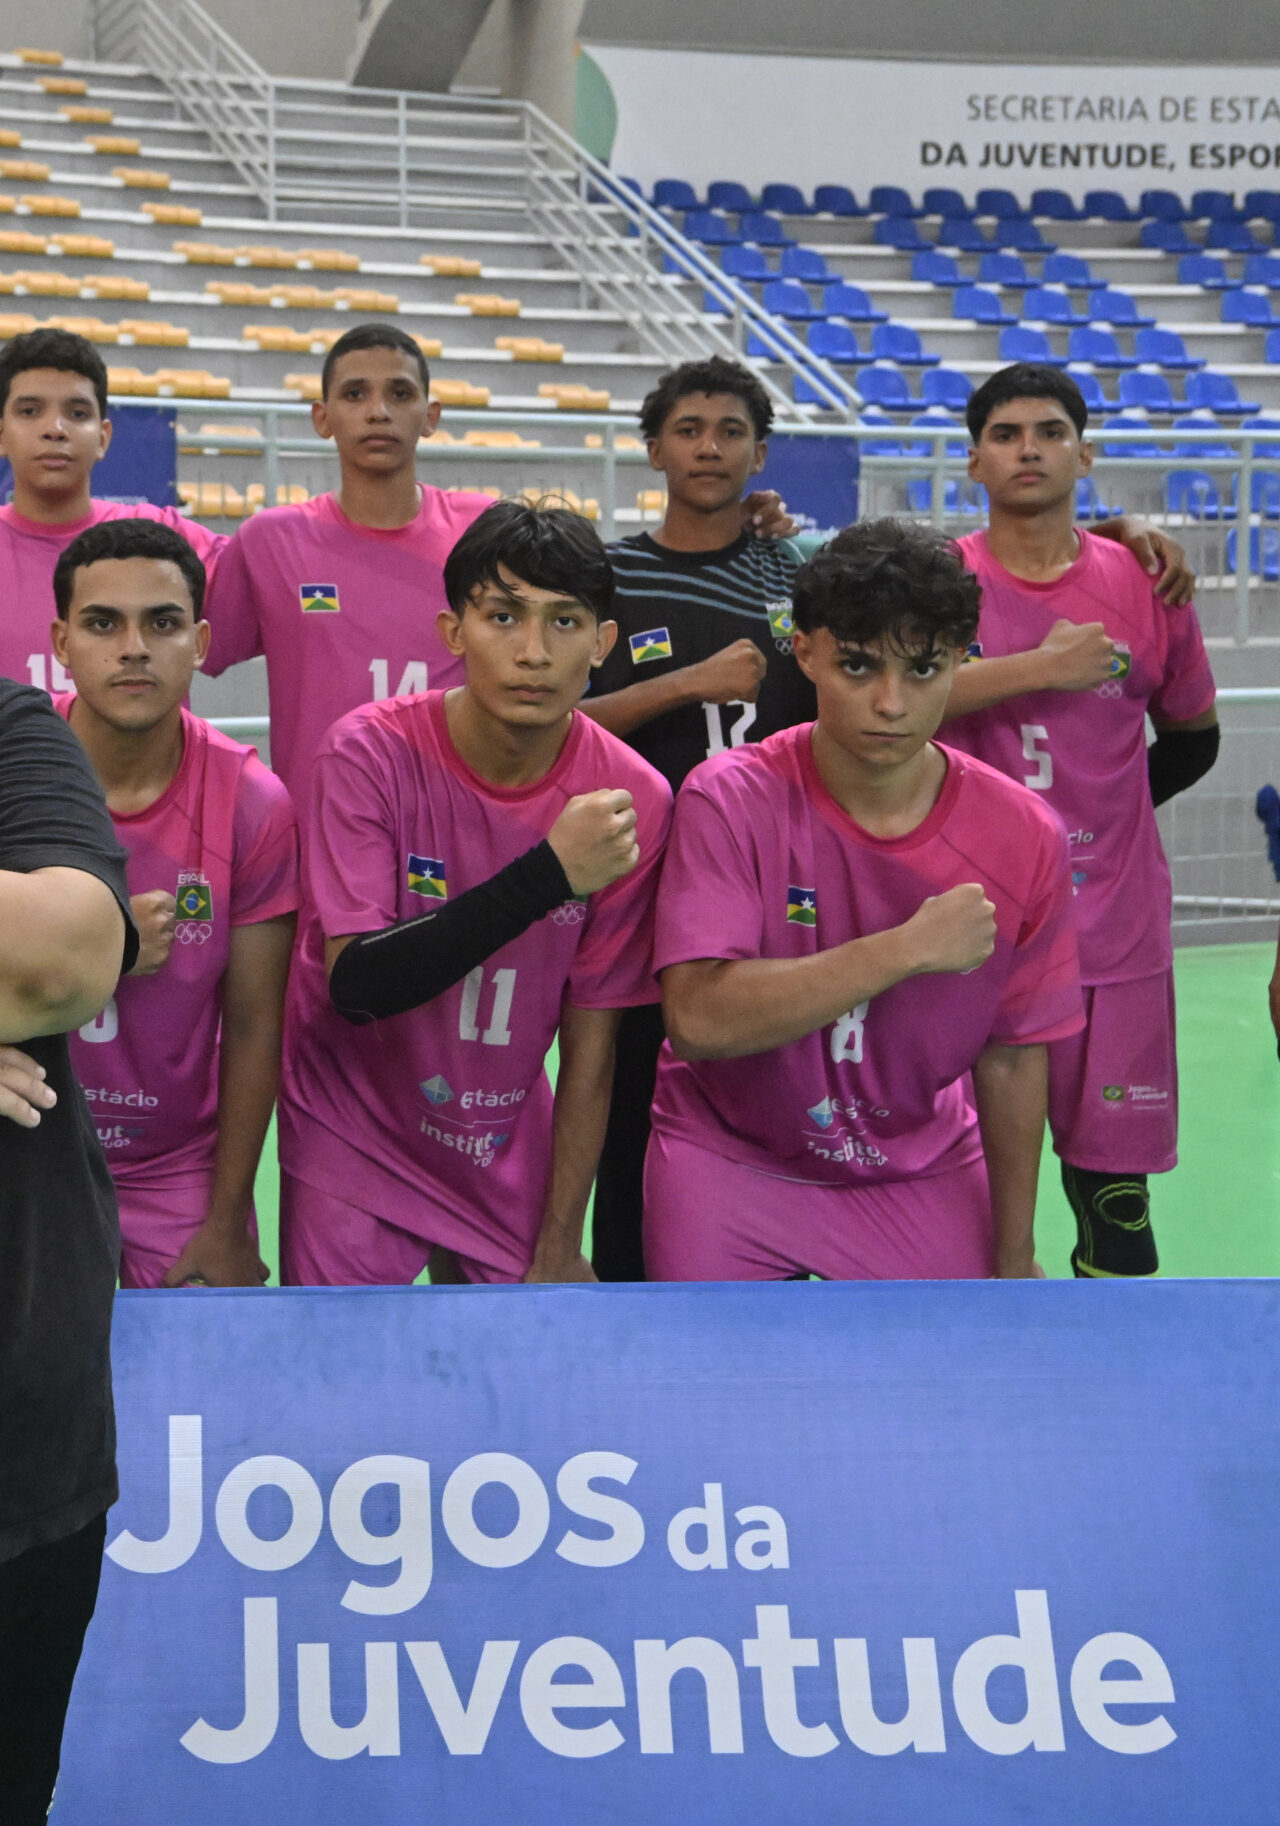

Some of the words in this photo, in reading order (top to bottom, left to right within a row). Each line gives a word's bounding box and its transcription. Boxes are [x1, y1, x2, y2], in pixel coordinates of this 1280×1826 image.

[966, 95, 1149, 122] SECRETARIA
[1159, 96, 1197, 122] DE
[920, 142, 968, 167] DA
[978, 142, 1176, 172] JUVENTUDE,
[368, 658, 428, 702] 14
[1020, 724, 1054, 790] 5
[459, 966, 517, 1046] 11
[830, 1000, 870, 1064] 8
[81, 1087, 159, 1108] stácio
[104, 1415, 646, 1616] Jogos
[666, 1483, 790, 1570] da
[179, 1589, 1179, 1764] Juventude
